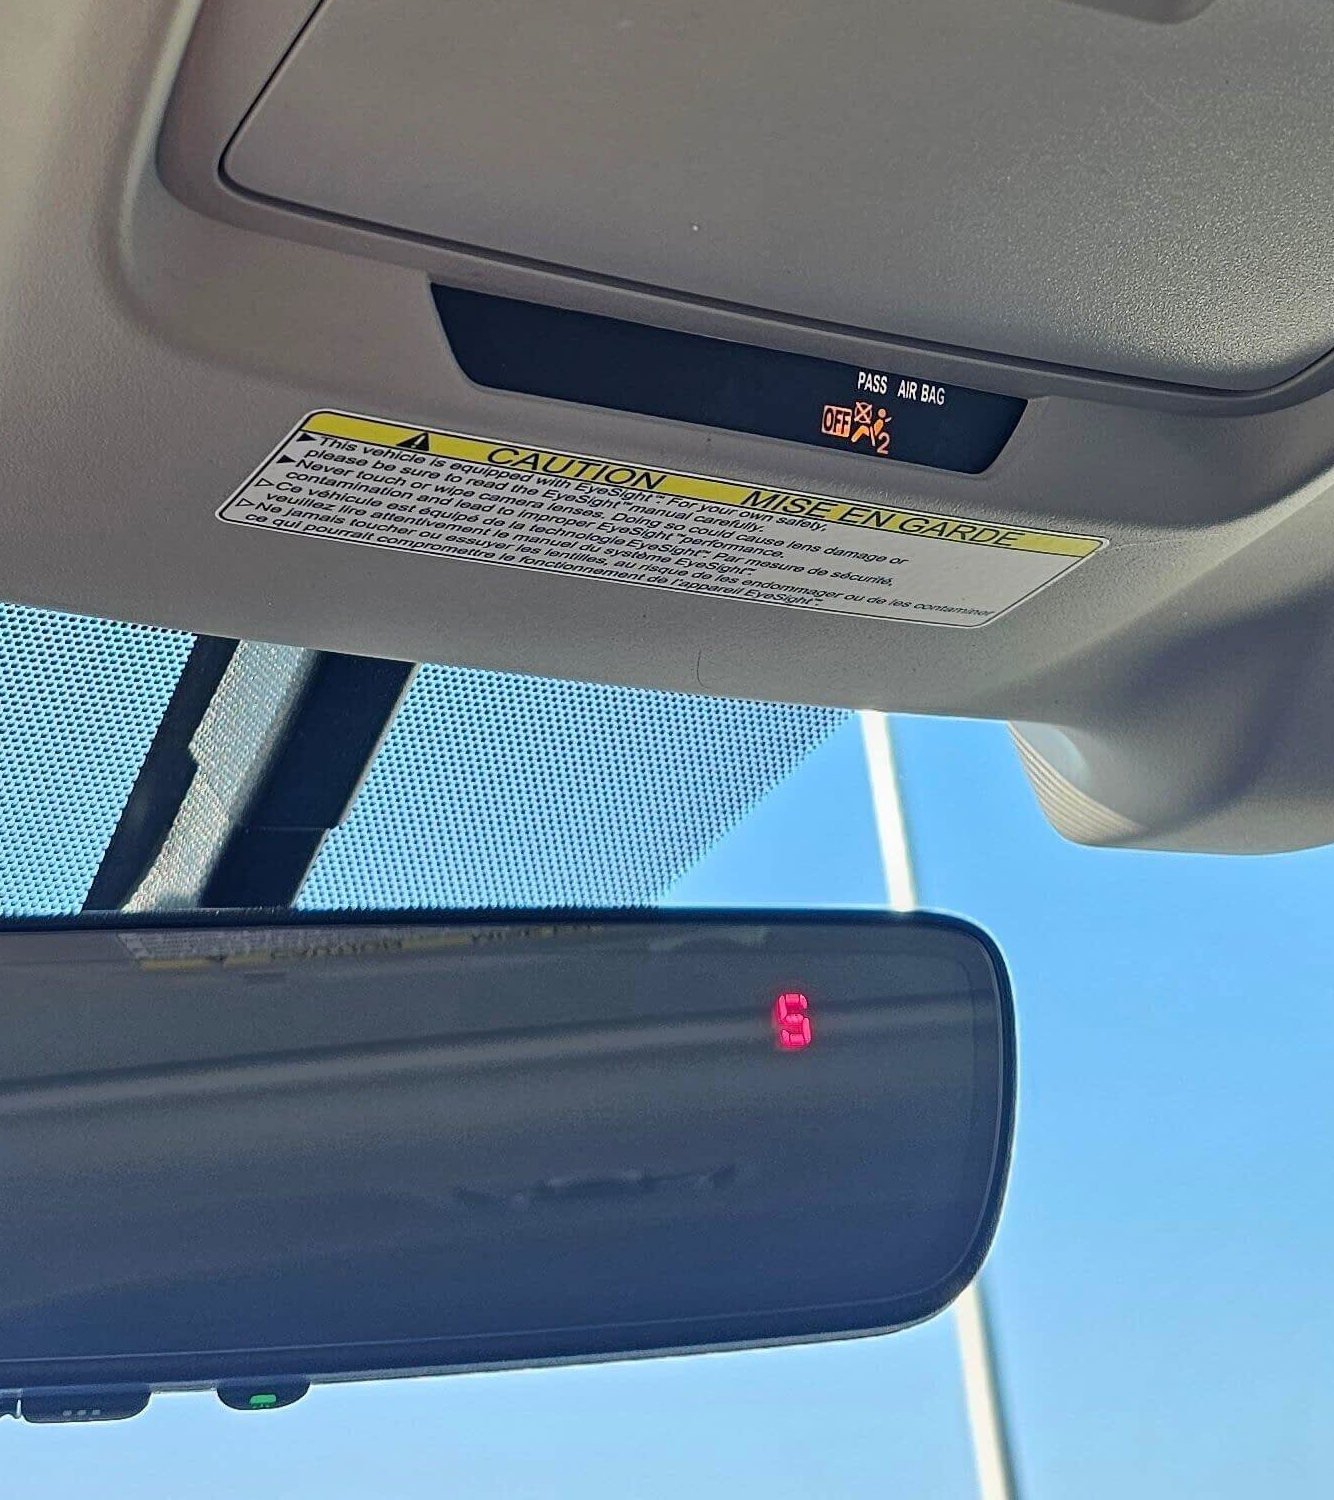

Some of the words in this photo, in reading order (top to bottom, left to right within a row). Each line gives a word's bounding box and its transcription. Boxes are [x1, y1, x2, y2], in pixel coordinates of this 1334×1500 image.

[823, 406, 851, 436] OFF
[857, 371, 888, 395] PASS
[897, 379, 917, 401] AIR
[920, 384, 945, 406] BAG
[303, 449, 369, 467] please
[370, 459, 397, 472] be
[399, 466, 441, 480] sure
[443, 472, 463, 483] to
[464, 477, 510, 491] read
[509, 483, 539, 496] the
[627, 504, 694, 521] manual
[693, 515, 765, 533] carefully.
[319, 435, 358, 452] This
[362, 446, 427, 464] vehicle
[428, 457, 447, 468] is
[448, 462, 535, 483] equipped
[535, 476, 572, 489] with
[665, 496, 699, 509] For
[695, 503, 739, 516] your
[738, 510, 774, 522] own
[775, 516, 828, 532] safety,
[486, 447, 668, 490] CAUTION
[244, 513, 268, 523] ce
[271, 518, 304, 529] qui
[301, 523, 375, 541] pourrait
[376, 535, 496, 559] compromettre
[497, 552, 516, 562] le
[517, 555, 646, 581] fonctionnement
[646, 575, 669, 584] de
[266, 492, 336, 512] veuillez
[337, 504, 367, 516] lire
[369, 511, 492, 536] attentivement
[491, 528, 510, 539] le
[511, 533, 579, 549] manuel
[578, 543, 602, 553] du
[602, 547, 672, 563] système
[275, 481, 303, 494] Ce
[307, 488, 383, 507] véhicule
[386, 502, 417, 513] est
[418, 506, 480, 523] équipé
[481, 516, 506, 527] de
[507, 520, 526, 530] la
[528, 523, 626, 546] technologie
[711, 551, 745, 563] Par
[743, 558, 805, 573] mesure
[806, 566, 829, 576] de
[829, 571, 893, 587] sécurité,
[284, 471, 414, 500] contamination
[415, 494, 455, 506] and
[453, 498, 496, 513] lead
[496, 505, 515, 516] to
[516, 508, 597, 528] improper
[677, 536, 784, 559] performance.
[294, 458, 355, 477] Never
[355, 470, 407, 487] touch
[409, 481, 433, 490] or
[433, 484, 476, 498] wipe
[478, 492, 545, 509] camera
[545, 501, 605, 520] lenses.
[610, 512, 663, 529] Doing
[662, 522, 686, 531] so
[687, 526, 737, 539] could
[735, 533, 785, 547] cause
[785, 539, 822, 553] lens
[822, 546, 888, 563] damage
[888, 557, 909, 565] or
[739, 490, 839, 519] MISE
[836, 506, 897, 528] EN
[897, 516, 1026, 547] GARDE
[254, 501, 283, 514] Ne
[281, 506, 346, 525] jamais
[348, 518, 418, 536] toucher
[417, 530, 443, 540] ou
[444, 534, 516, 550] essuyer
[514, 543, 542, 555] les
[543, 547, 608, 566] lentilles,
[613, 560, 637, 569] au
[637, 563, 689, 577] risque
[690, 570, 713, 580] de
[713, 573, 740, 584] les
[740, 579, 845, 599] endommager
[843, 593, 866, 602] ou
[865, 596, 887, 605] de
[887, 598, 913, 608] les
